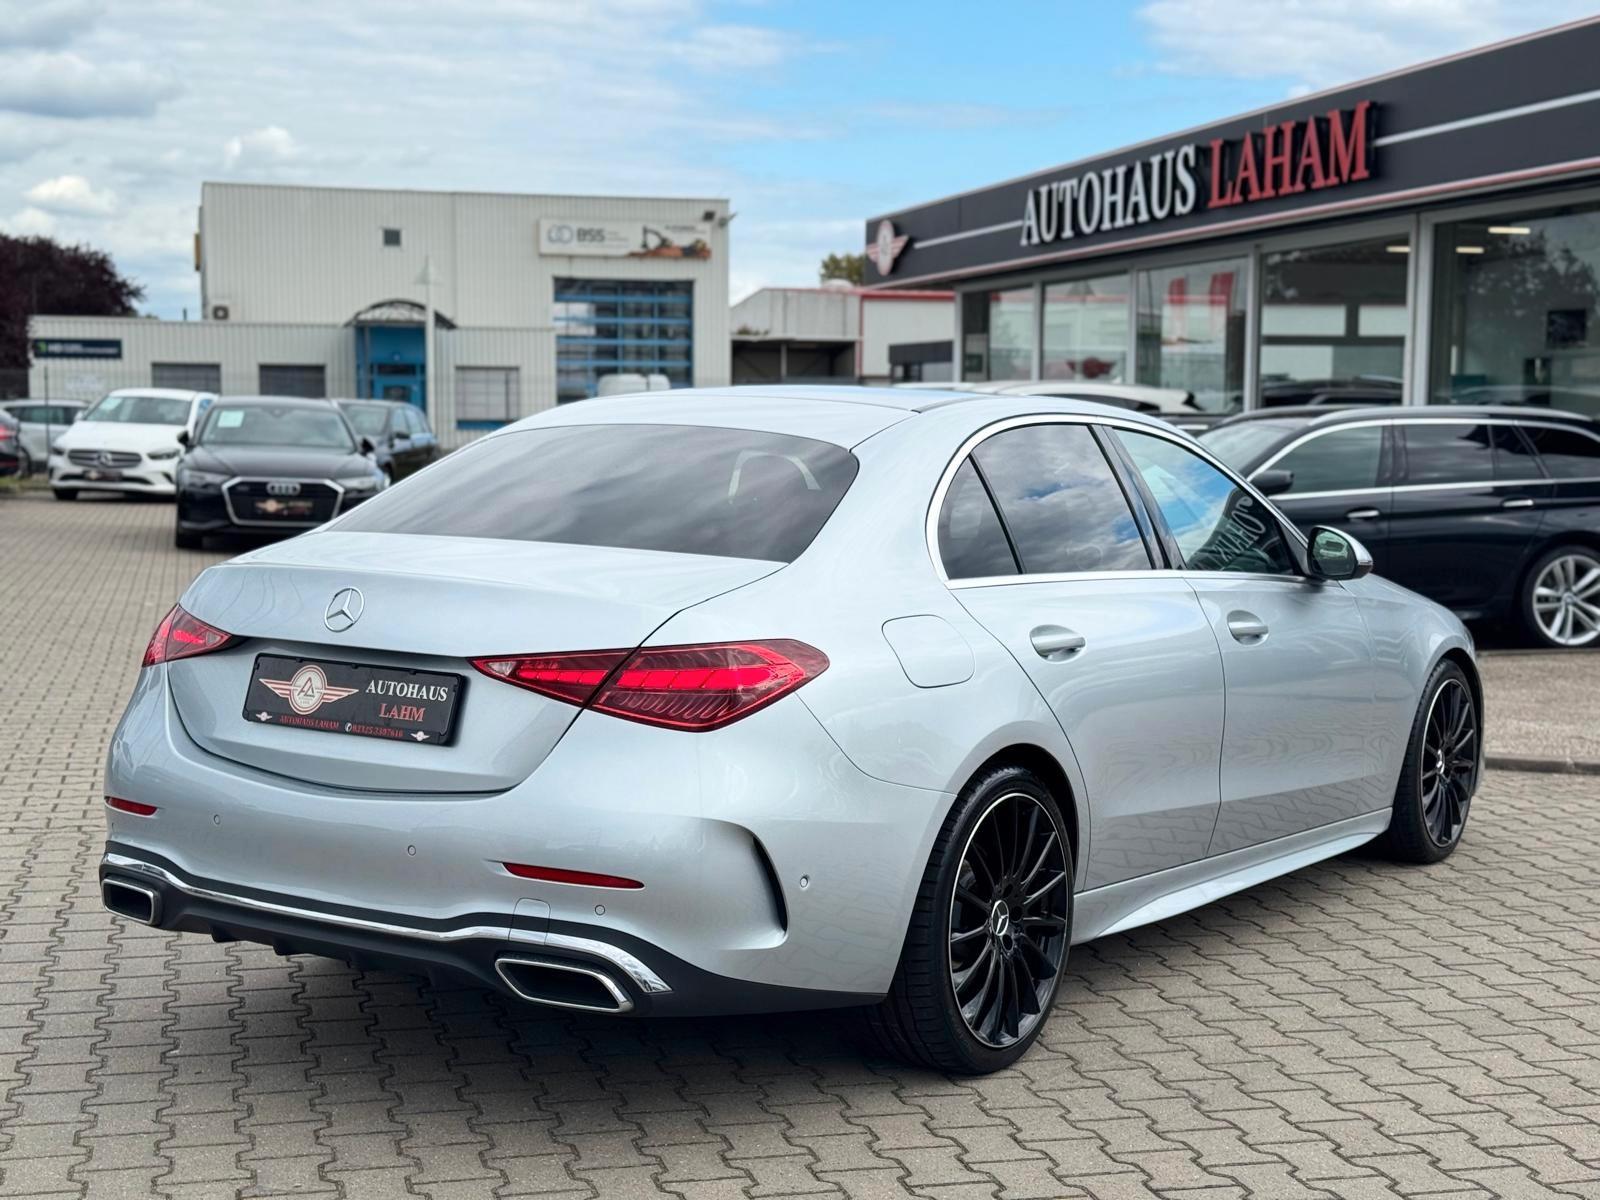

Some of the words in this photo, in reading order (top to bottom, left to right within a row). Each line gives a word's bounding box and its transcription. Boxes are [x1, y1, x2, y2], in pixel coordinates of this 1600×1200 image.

[1020, 144, 1196, 246] AUTOHAUS
[1207, 100, 1371, 208] LAHAM
[366, 679, 448, 701] AUTOHAUS
[378, 703, 426, 722] LAHM
